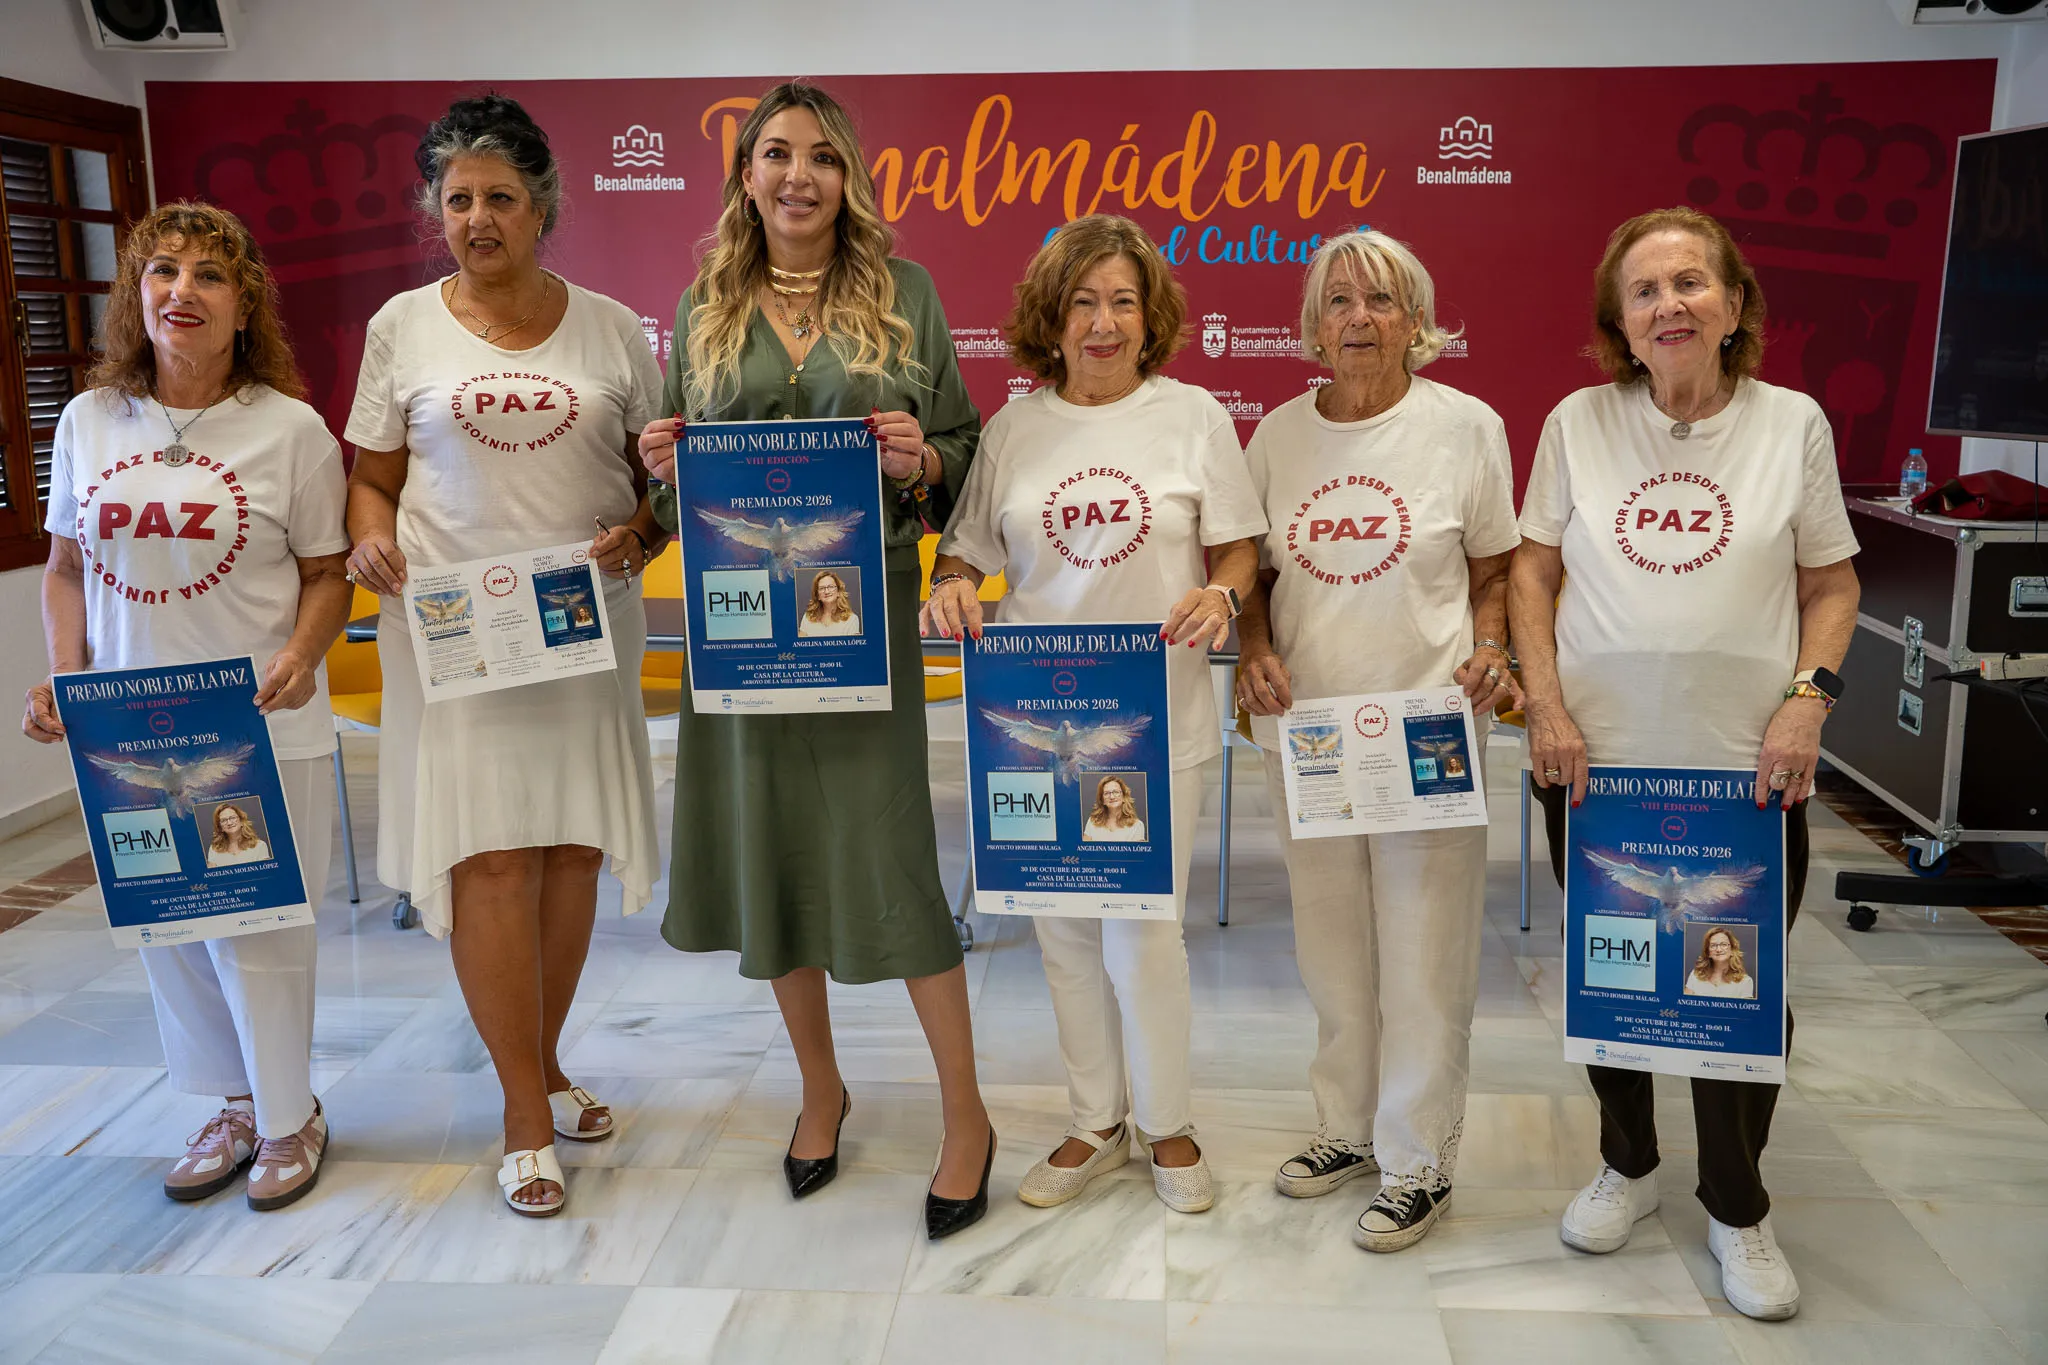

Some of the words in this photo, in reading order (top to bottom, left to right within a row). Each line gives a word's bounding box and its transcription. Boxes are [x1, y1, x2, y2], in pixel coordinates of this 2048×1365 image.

[700, 94, 1386, 227] nalmádena
[594, 173, 686, 191] Benalmádena
[1417, 166, 1512, 184] Benalmádena
[950, 327, 988, 335] untamiento
[990, 327, 998, 335] de
[1231, 326, 1280, 336] Ayuntamiento
[1281, 326, 1290, 334] de
[1231, 336, 1303, 350] Benalmáden
[456, 381, 471, 392] LA
[470, 373, 498, 383] PAZ
[502, 372, 551, 383] DESDE
[475, 391, 556, 414] PAZ
[1232, 390, 1242, 398] de
[451, 394, 465, 420] POR
[462, 421, 519, 453] JUNTOS
[688, 433, 745, 453] PREMIO
[747, 432, 797, 451] NOBLE
[800, 431, 820, 450] DE
[822, 431, 840, 449] LA
[842, 430, 869, 448] PAZ
[101, 454, 144, 480] PAZ
[153, 450, 225, 473] DSDE
[1059, 471, 1085, 490] PAZ
[1089, 467, 1132, 484] DESDE
[1347, 475, 1394, 496] DESDE
[1640, 473, 1667, 491] PAZ
[1672, 472, 1720, 493] DESDE
[80, 485, 99, 508] LA
[1045, 491, 1060, 506] LA
[1311, 478, 1341, 500] PAZ
[1623, 491, 1641, 506] LA
[730, 495, 802, 508] PREMIADOS
[805, 494, 832, 506] 2026
[1294, 502, 1311, 518] LA
[98, 502, 219, 540] PAZ
[1042, 510, 1057, 538] POR
[1062, 499, 1130, 530] PAZ
[1615, 508, 1629, 534] POR
[1635, 508, 1712, 533] PAZ
[77, 516, 93, 560] POR
[1286, 522, 1299, 551] POR
[1309, 516, 1389, 542] PAZ
[1053, 539, 1094, 569] JUNTOS
[1617, 537, 1666, 574] JUNTOS
[1294, 553, 1343, 585] JUNTOS
[93, 562, 169, 604] JUNTOS
[492, 577, 510, 585] PAZ
[708, 590, 765, 612] PHM
[419, 618, 442, 630] Juntos
[461, 612, 474, 621] Paz
[975, 635, 1032, 654] PREMIO
[1034, 634, 1085, 653] NOBLE
[1087, 634, 1108, 652] DE
[1110, 634, 1128, 652] LA
[1130, 633, 1158, 652] PAZ
[66, 682, 123, 703] PREMIO
[124, 675, 174, 697] NOBLE
[176, 673, 199, 691] DE
[199, 671, 221, 689] LA
[219, 667, 248, 686] PAZ
[1016, 698, 1089, 709] PREMIADOS
[1091, 698, 1118, 709] 2026
[1363, 717, 1380, 725] PAZ
[118, 736, 189, 752] PREMIADOS
[191, 732, 220, 745] 2026
[1291, 752, 1313, 763] Juntos
[1331, 749, 1344, 758] Paz
[1297, 763, 1339, 772] Benalmádena
[1586, 777, 1641, 796] REMIO
[1644, 777, 1697, 798] NOBLE
[1701, 779, 1723, 798] DE
[1725, 780, 1745, 799] LA
[993, 792, 1049, 813] PHM
[110, 828, 170, 852] PHM
[1621, 842, 1698, 857] PREMIADOS
[1701, 846, 1731, 858] 2026
[1590, 936, 1649, 962] PHM
[1631, 1026, 1650, 1034] CASA
[1674, 1029, 1710, 1039] CULTURA
